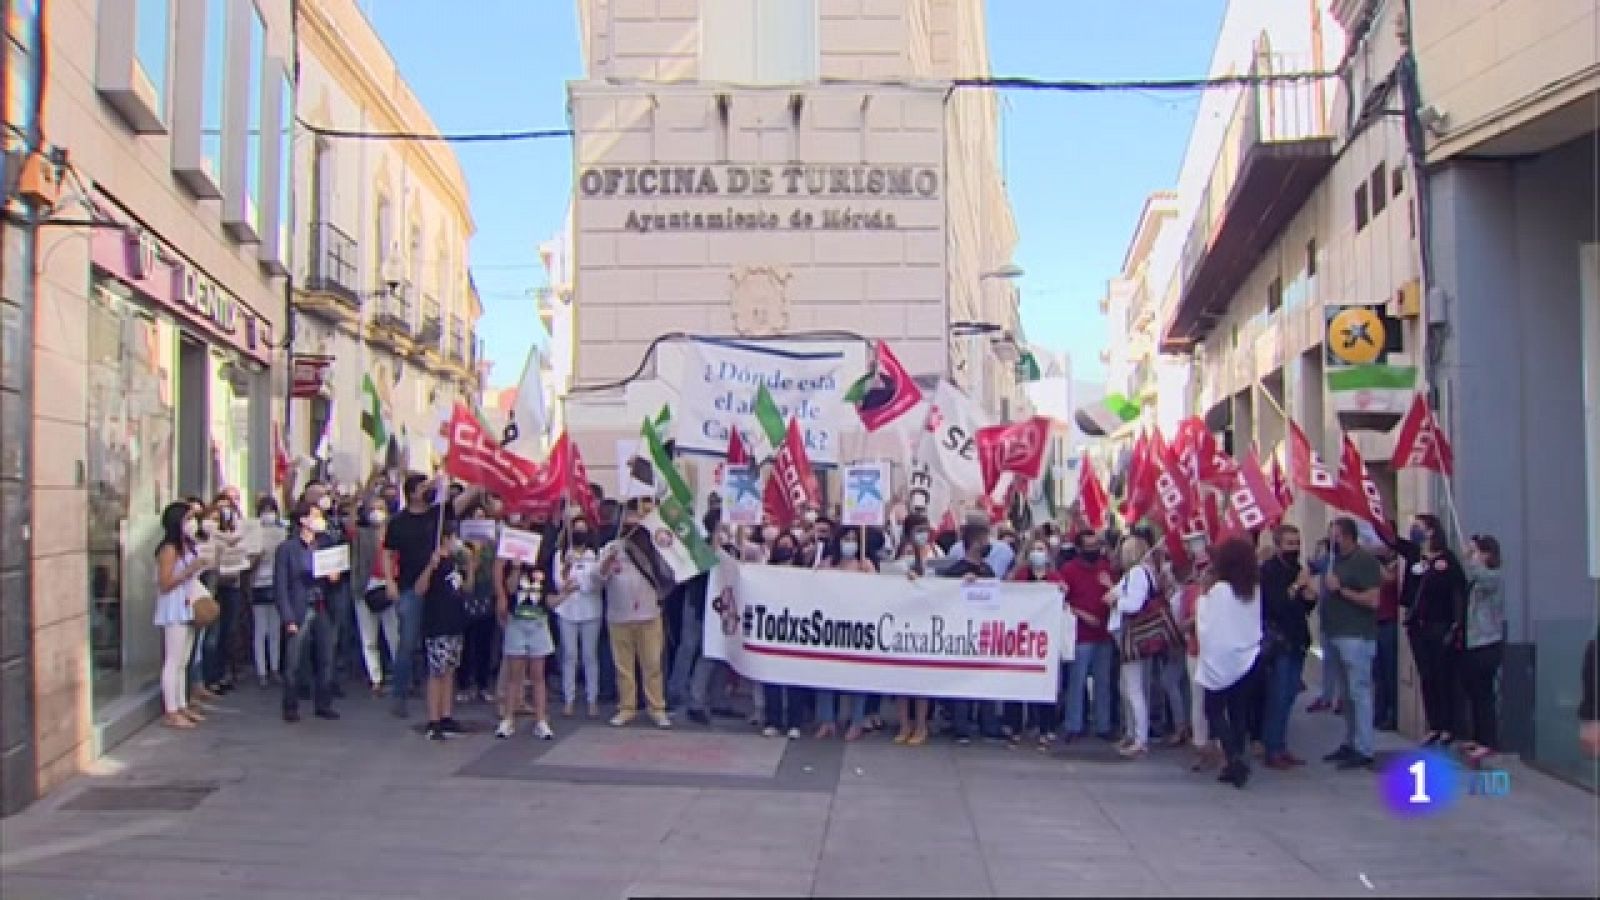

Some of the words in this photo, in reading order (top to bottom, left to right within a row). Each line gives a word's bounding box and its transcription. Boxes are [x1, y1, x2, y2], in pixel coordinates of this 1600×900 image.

[579, 167, 717, 196] OFICINA
[727, 168, 773, 194] DE
[781, 168, 938, 197] TURISMO
[624, 207, 780, 233] Ayuntamiento
[789, 207, 814, 229] de
[714, 391, 734, 411] el
